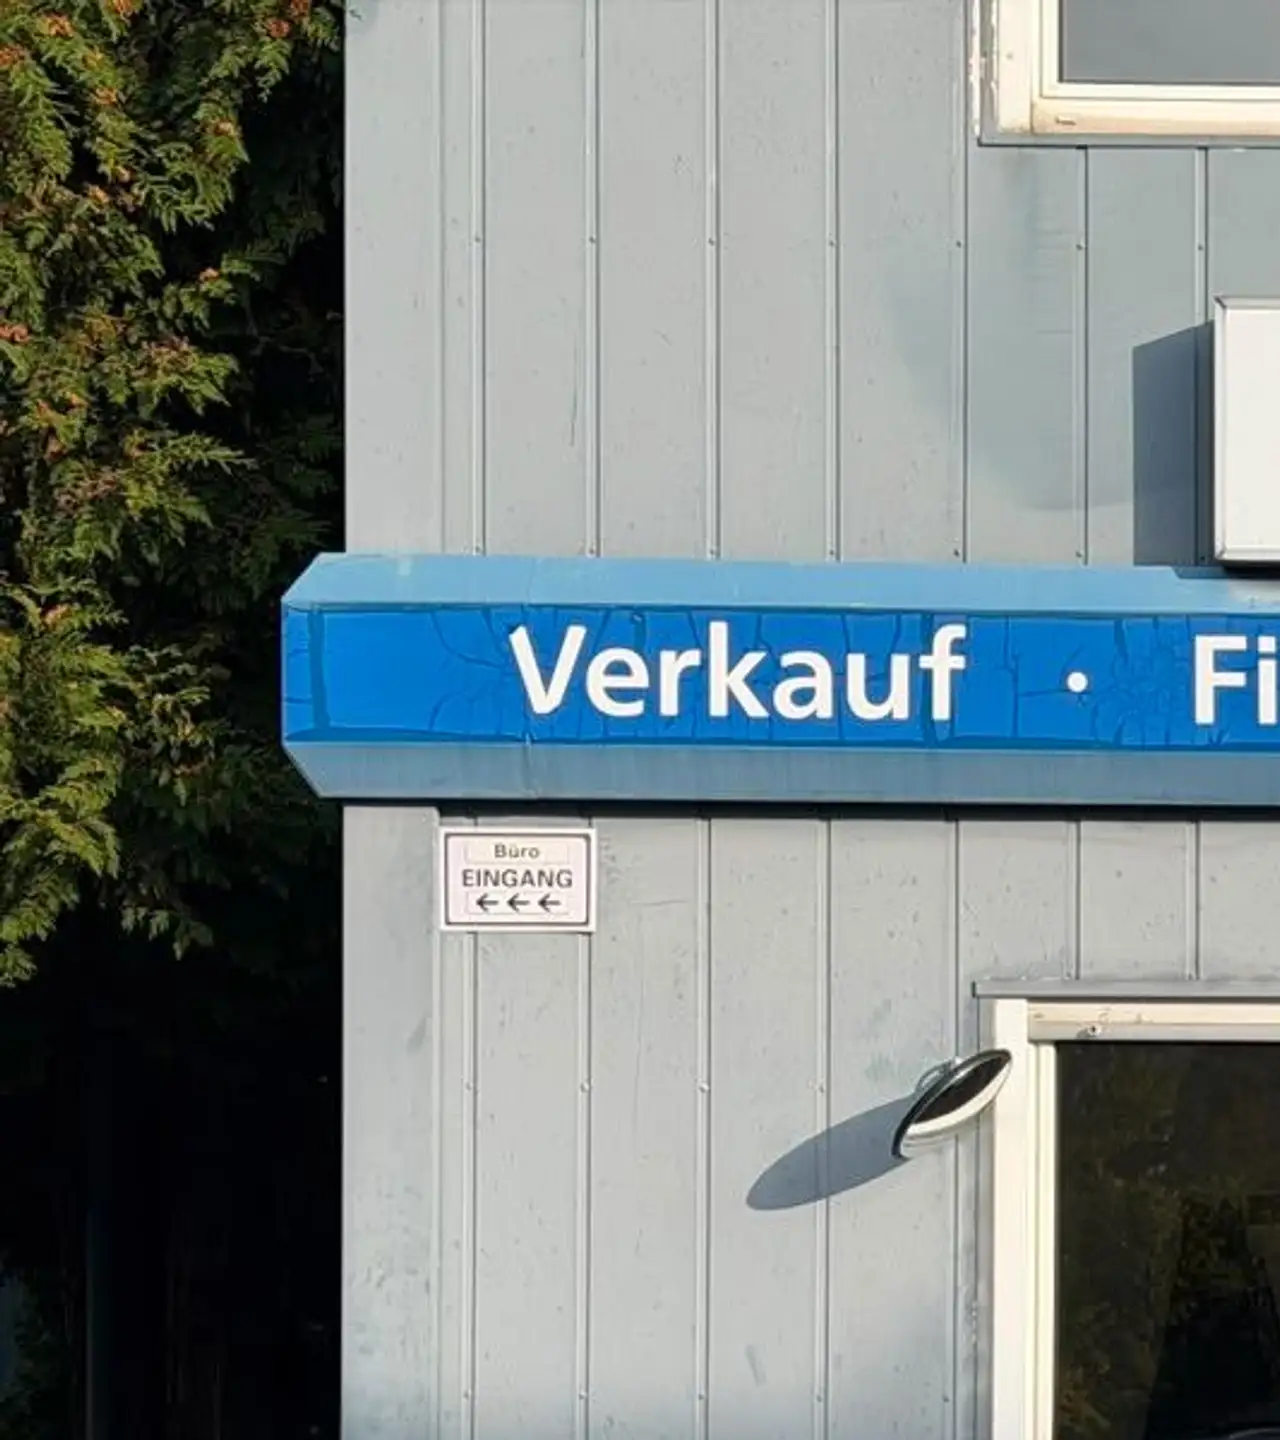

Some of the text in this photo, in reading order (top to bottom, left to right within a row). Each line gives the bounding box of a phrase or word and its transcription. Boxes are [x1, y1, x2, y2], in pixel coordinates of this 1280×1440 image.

[508, 621, 966, 720] Verkauf
[494, 843, 540, 859] Büro
[462, 868, 573, 889] EINGANG
